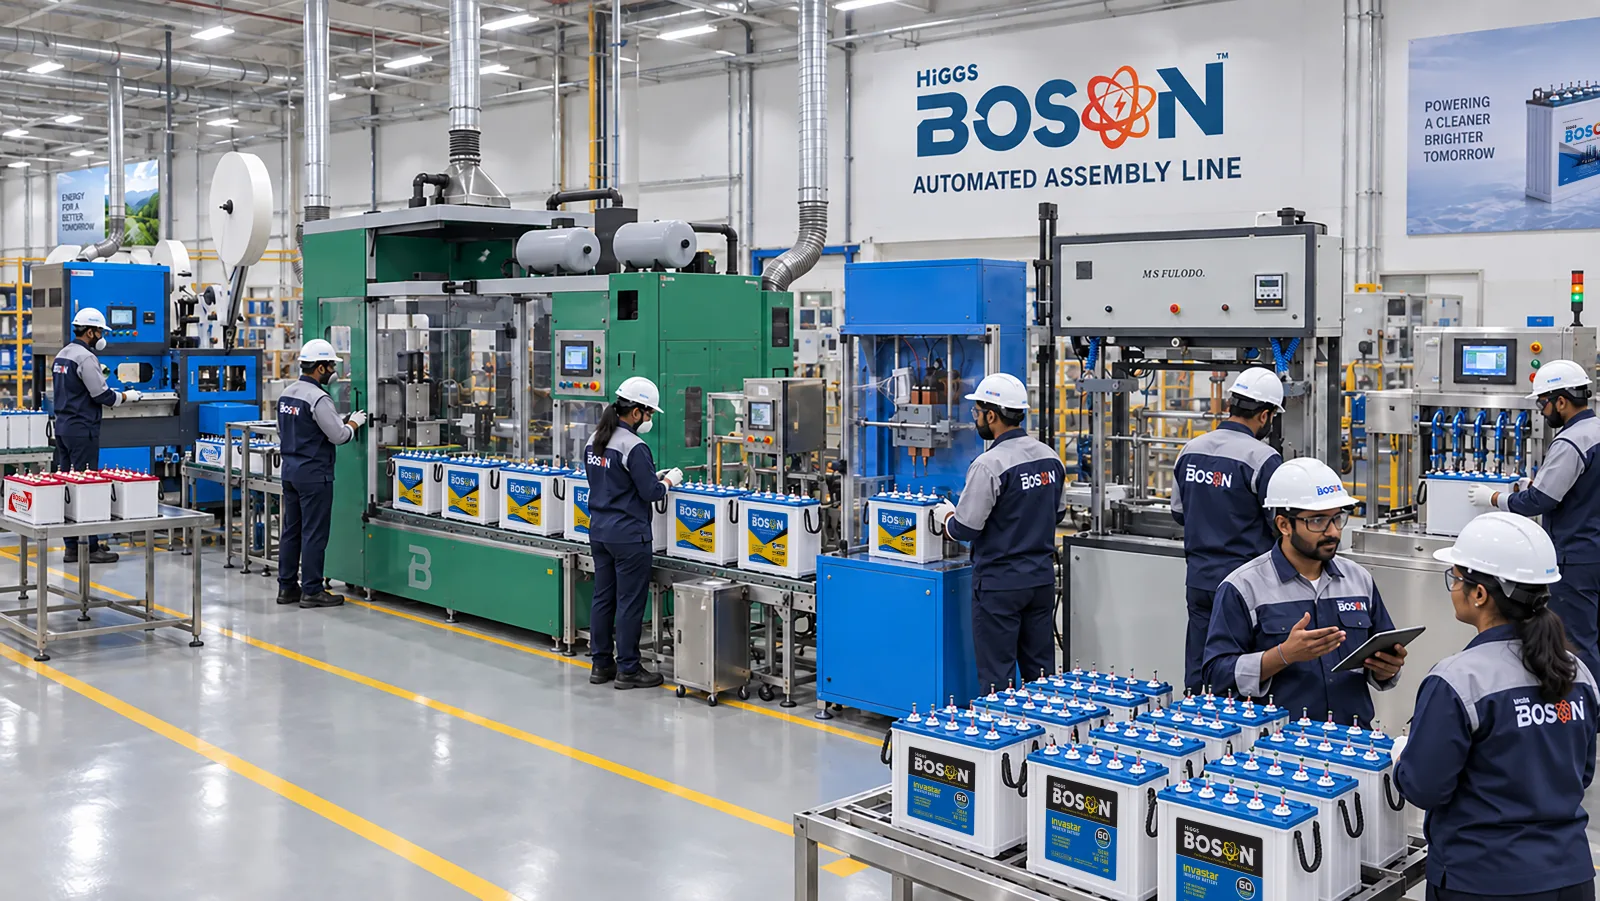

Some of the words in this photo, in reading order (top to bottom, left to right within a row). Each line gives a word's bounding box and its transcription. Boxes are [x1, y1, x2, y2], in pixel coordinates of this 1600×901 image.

[1425, 96, 1491, 113] POWERING
[1425, 118, 1433, 130] A
[1436, 113, 1491, 129] CLEANER
[1424, 131, 1483, 146] BRIGHTER
[1424, 147, 1495, 162] TOMORROW
[913, 169, 1037, 194] AUTOMATED
[1044, 160, 1171, 188] ASSEMBLY
[1182, 156, 1242, 181] LINE
[62, 192, 85, 201] ENERGY
[62, 203, 73, 211] FOR
[75, 202, 79, 210] A
[62, 212, 84, 222] BETTER
[62, 222, 95, 231] TOMORROW
[1021, 470, 1056, 490] BOSON
[1185, 468, 1232, 488] BOSON
[408, 544, 432, 590] B
[1515, 700, 1585, 728] BOSON
[914, 756, 969, 784] BOSON
[1052, 787, 1110, 818] BOSON
[1097, 831, 1108, 841] 60
[1184, 831, 1254, 866] BOSON
[1239, 880, 1252, 891] 60
